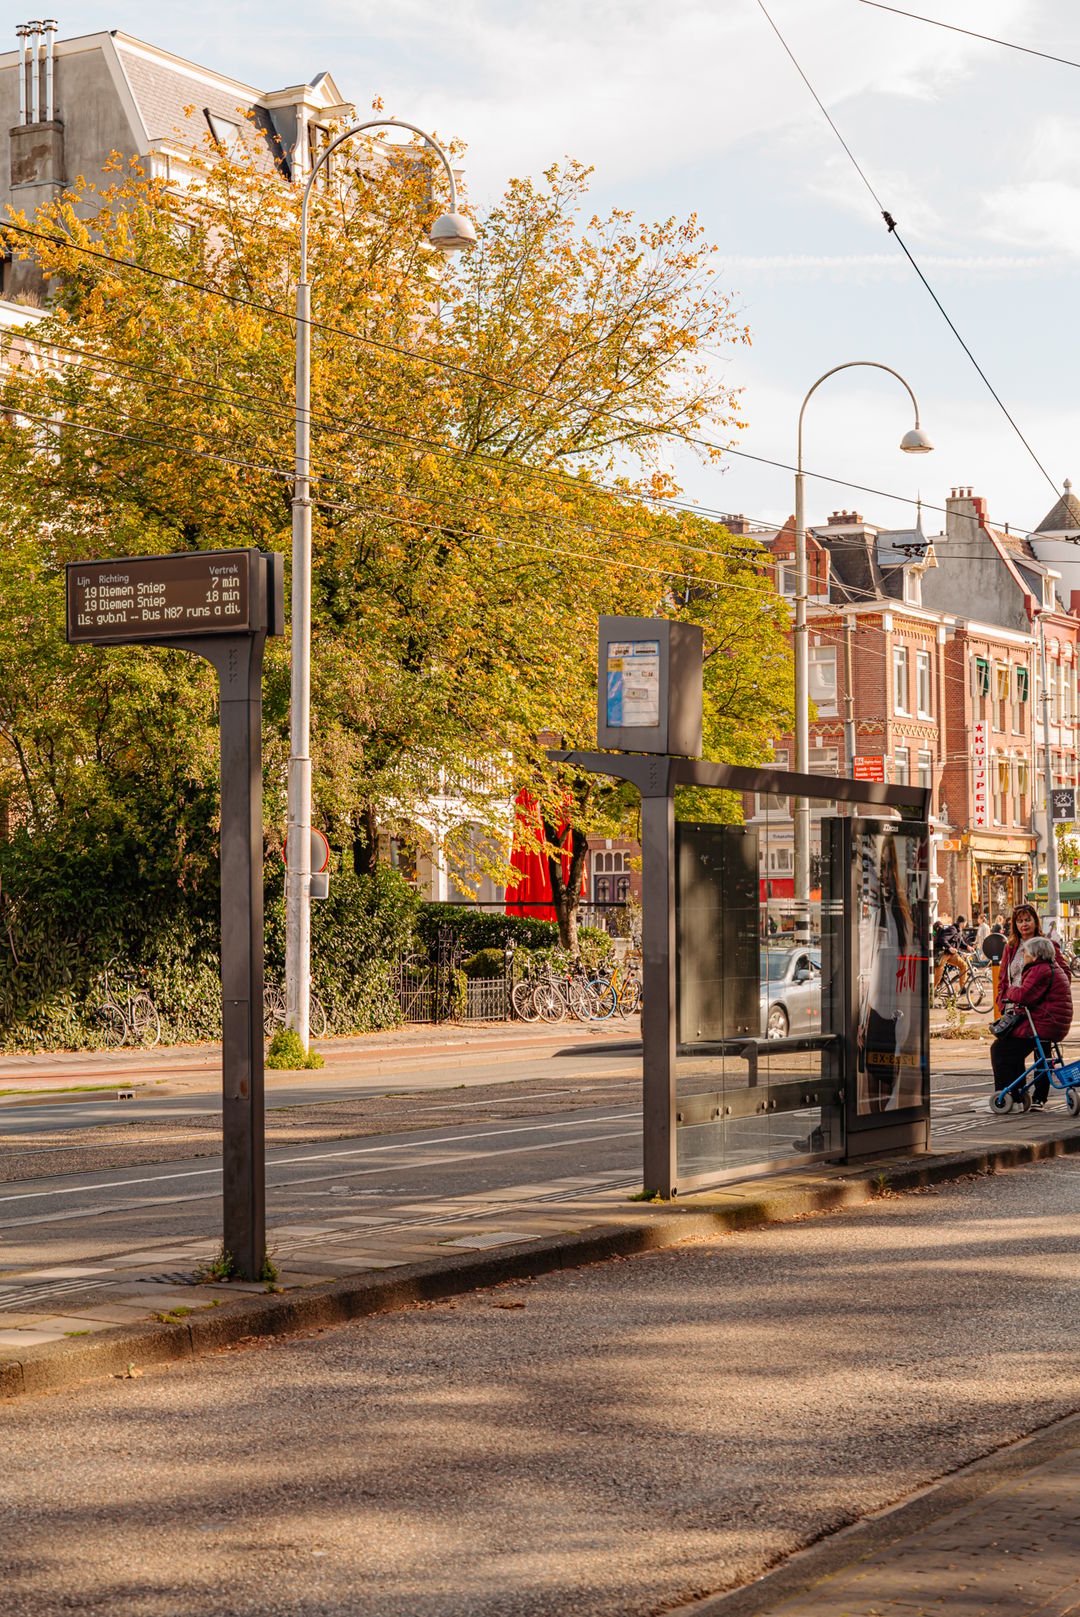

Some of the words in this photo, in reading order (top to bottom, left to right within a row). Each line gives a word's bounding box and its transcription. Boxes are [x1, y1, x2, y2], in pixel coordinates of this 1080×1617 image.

[77, 576, 91, 587] Lijn
[98, 573, 129, 584] Richting
[209, 564, 239, 575] Vertrek
[84, 586, 97, 599] 19
[99, 586, 134, 598] Diemen
[137, 582, 166, 595] Sniep
[211, 576, 219, 589] 7
[222, 575, 240, 588] min
[84, 599, 97, 612] 19
[99, 599, 134, 611] Diemen
[137, 595, 166, 608] Sniep
[205, 590, 219, 603] 18
[222, 589, 240, 602] min
[96, 610, 127, 625] gvb.nl
[141, 609, 161, 621] Bus
[164, 606, 184, 619] N87
[186, 606, 211, 618] runs
[214, 605, 221, 616] a
[974, 735, 985, 813] KUIJPER
